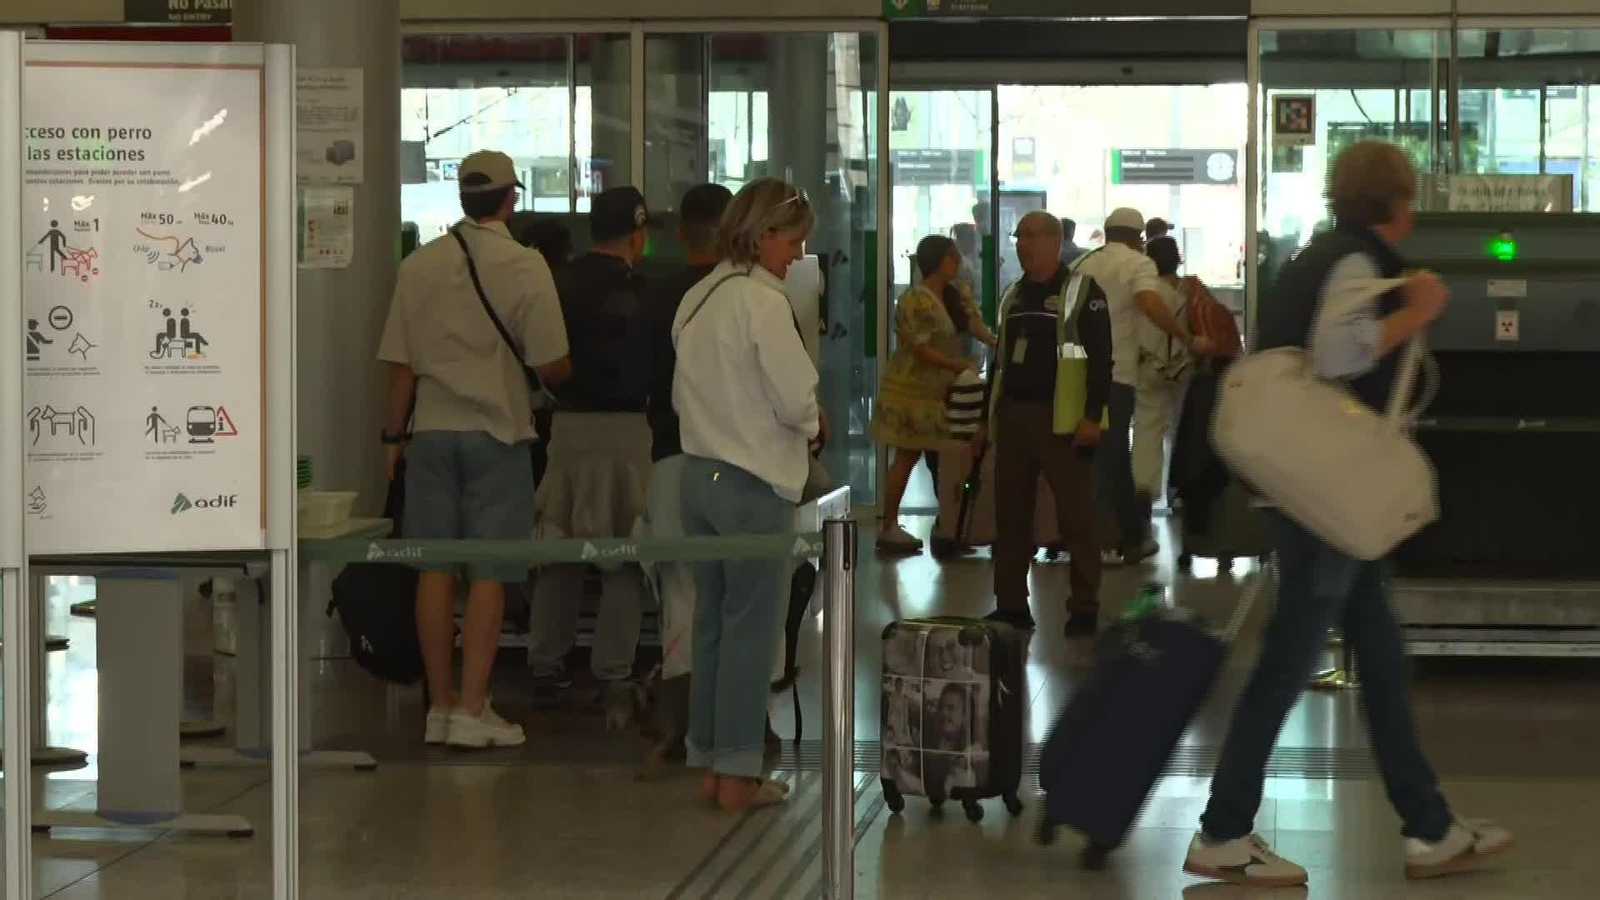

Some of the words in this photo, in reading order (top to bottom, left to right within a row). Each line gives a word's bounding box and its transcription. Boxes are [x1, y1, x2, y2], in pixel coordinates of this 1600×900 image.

[168, 0, 188, 10] No
[25, 126, 65, 139] ceso
[71, 126, 100, 139] con
[107, 126, 152, 142] perro
[27, 145, 51, 161] las
[56, 145, 146, 161] estaciones
[93, 218, 99, 231] 1
[159, 214, 175, 225] 50
[211, 214, 227, 225] 40
[194, 494, 239, 509] adif
